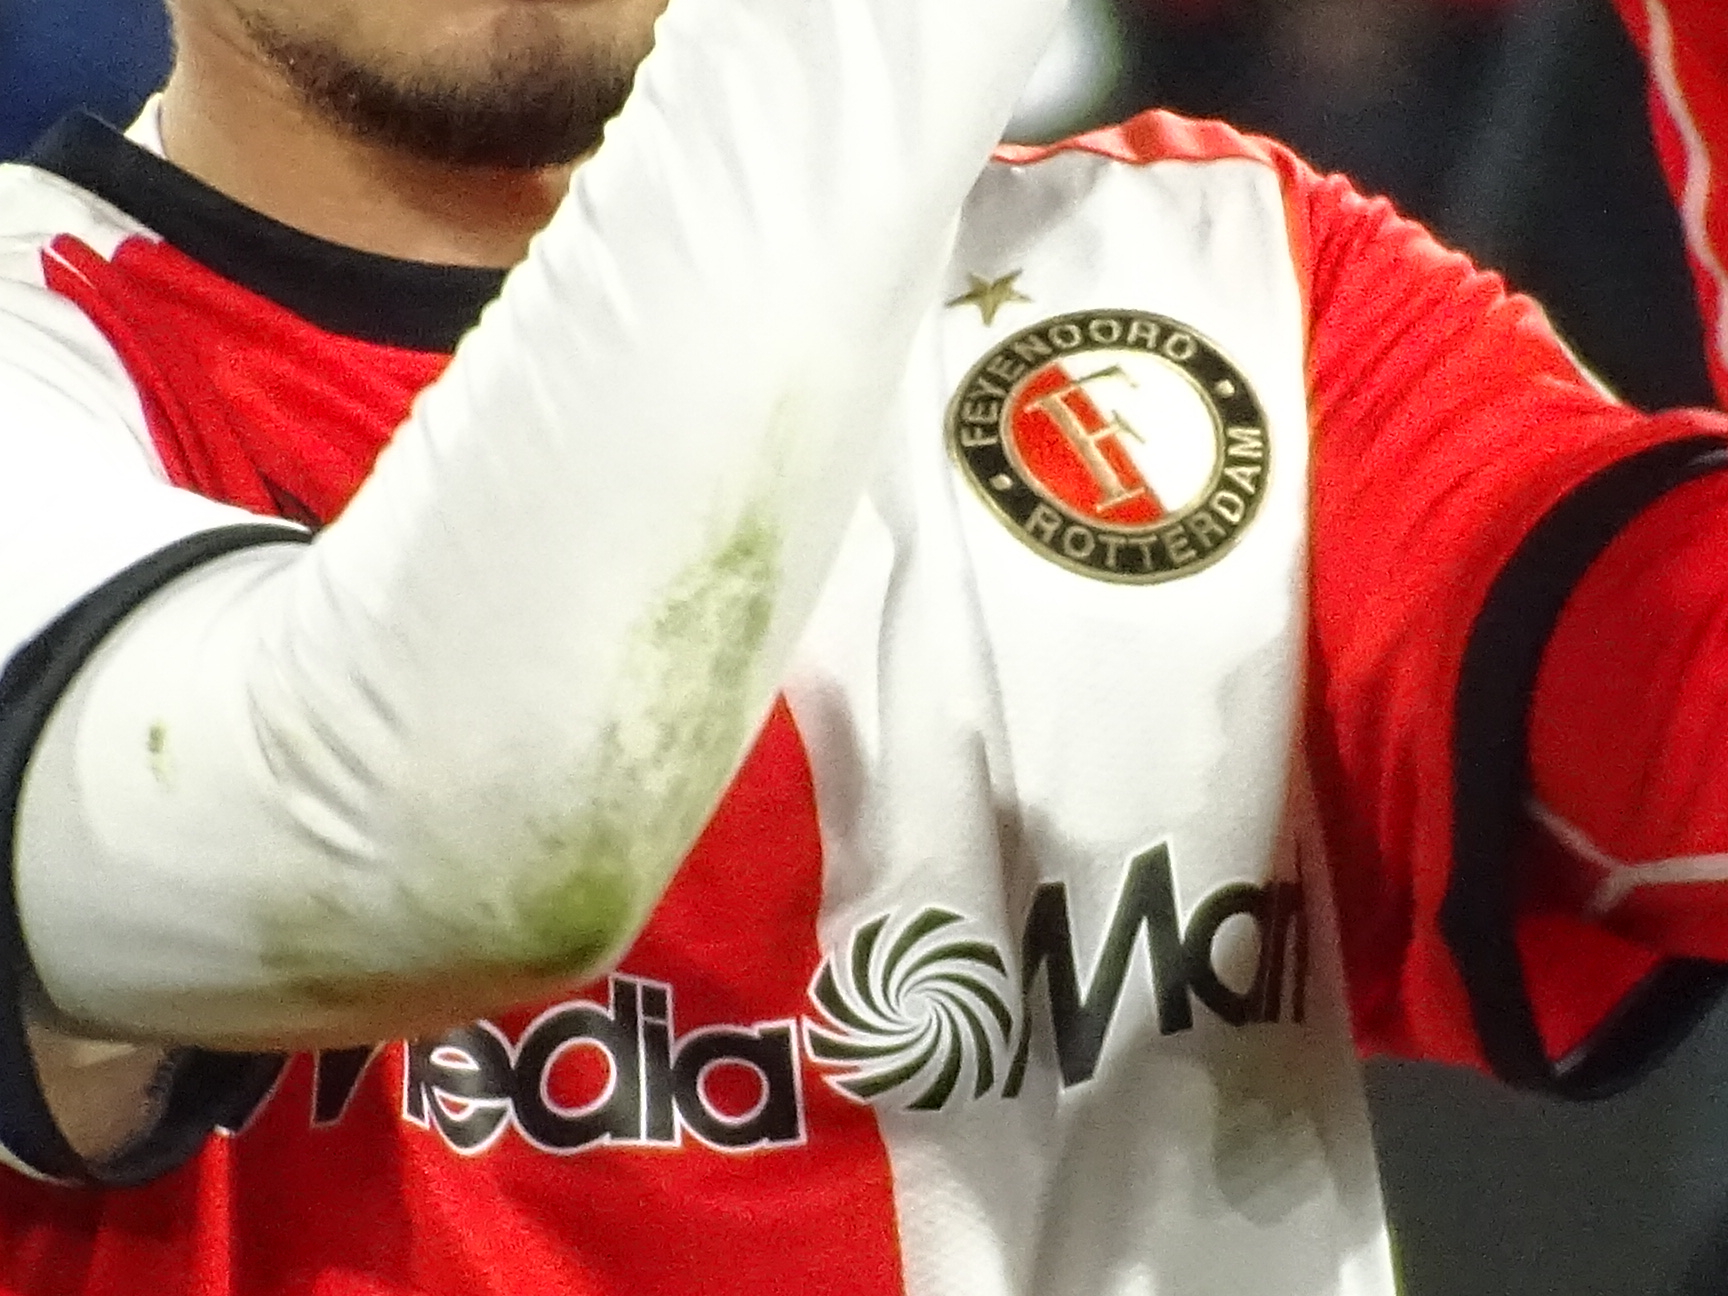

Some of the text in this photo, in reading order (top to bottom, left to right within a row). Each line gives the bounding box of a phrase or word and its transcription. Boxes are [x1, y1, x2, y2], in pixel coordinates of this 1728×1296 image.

[960, 317, 1199, 448] FEYENOORD
[1023, 425, 1265, 571] ROTTERDAM
[213, 971, 807, 1155] edia
